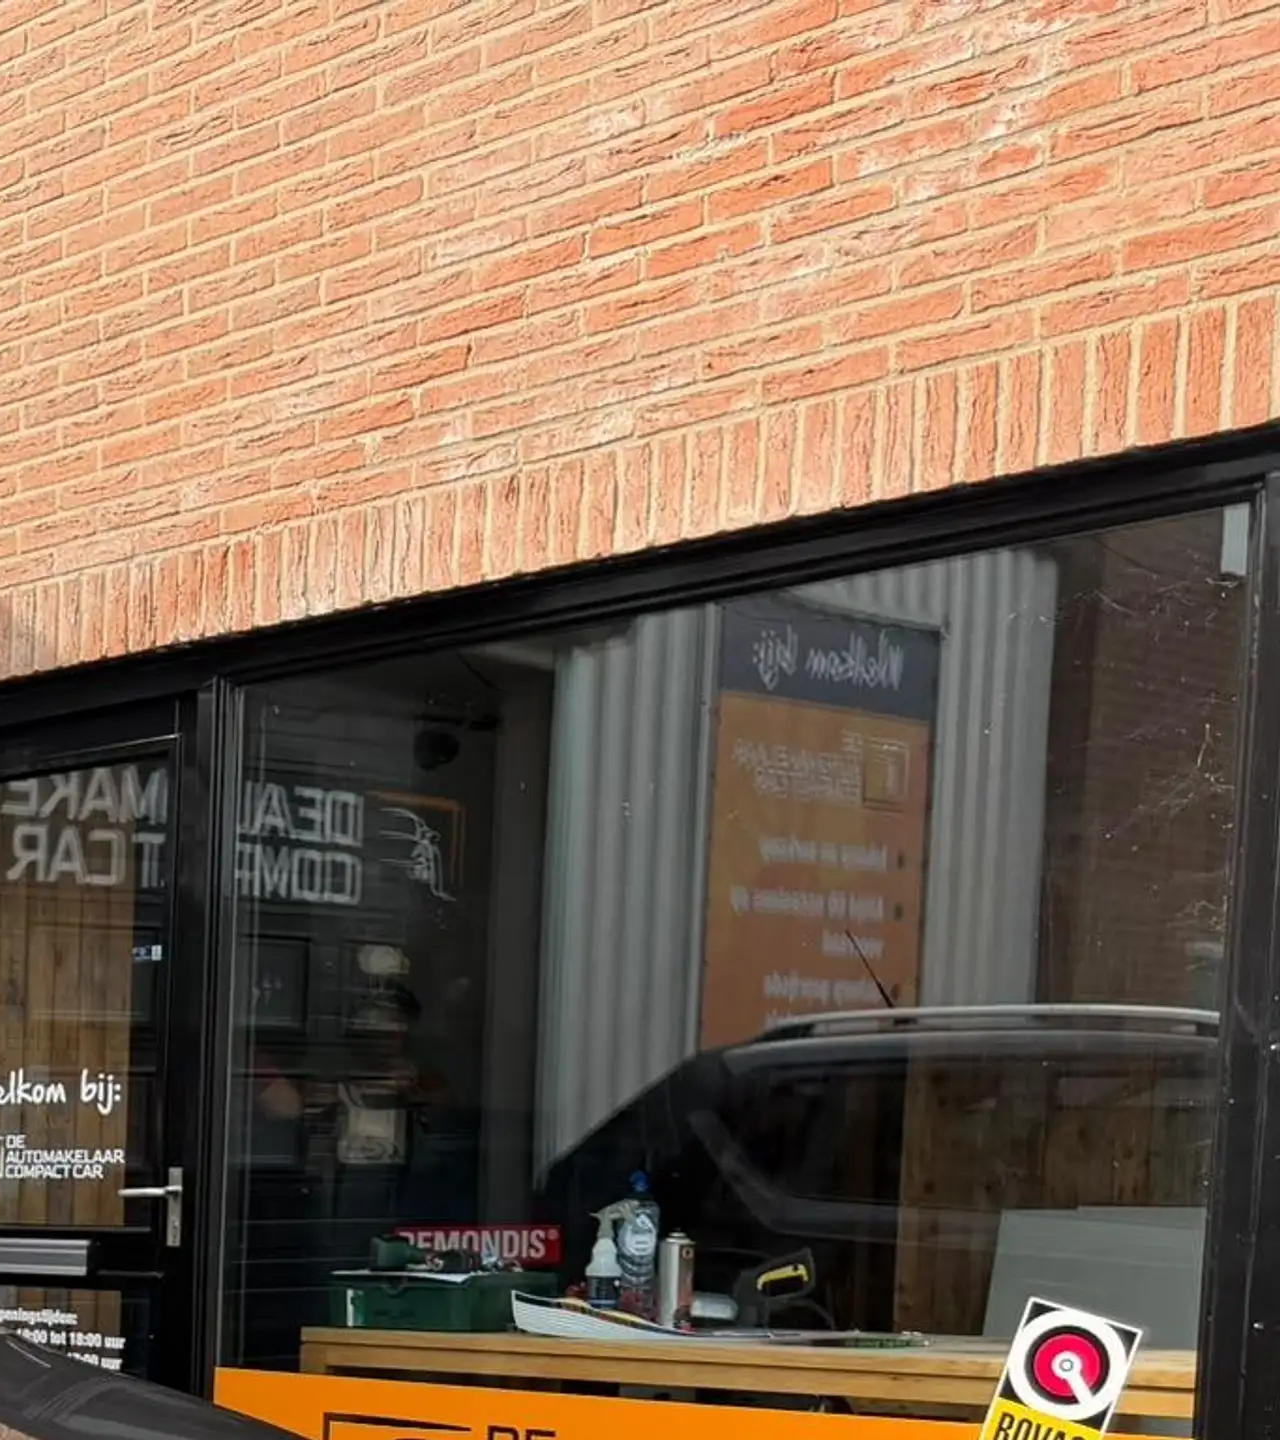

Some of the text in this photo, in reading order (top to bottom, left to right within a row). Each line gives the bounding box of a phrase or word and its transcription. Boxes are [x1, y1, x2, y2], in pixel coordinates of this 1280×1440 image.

[79, 1067, 122, 1116] bij:
[5, 1134, 27, 1149] DE
[5, 1149, 126, 1165] AUTOMAKELAAR
[5, 1164, 104, 1179] COMPACT CAR
[104, 1335, 128, 1350] uur
